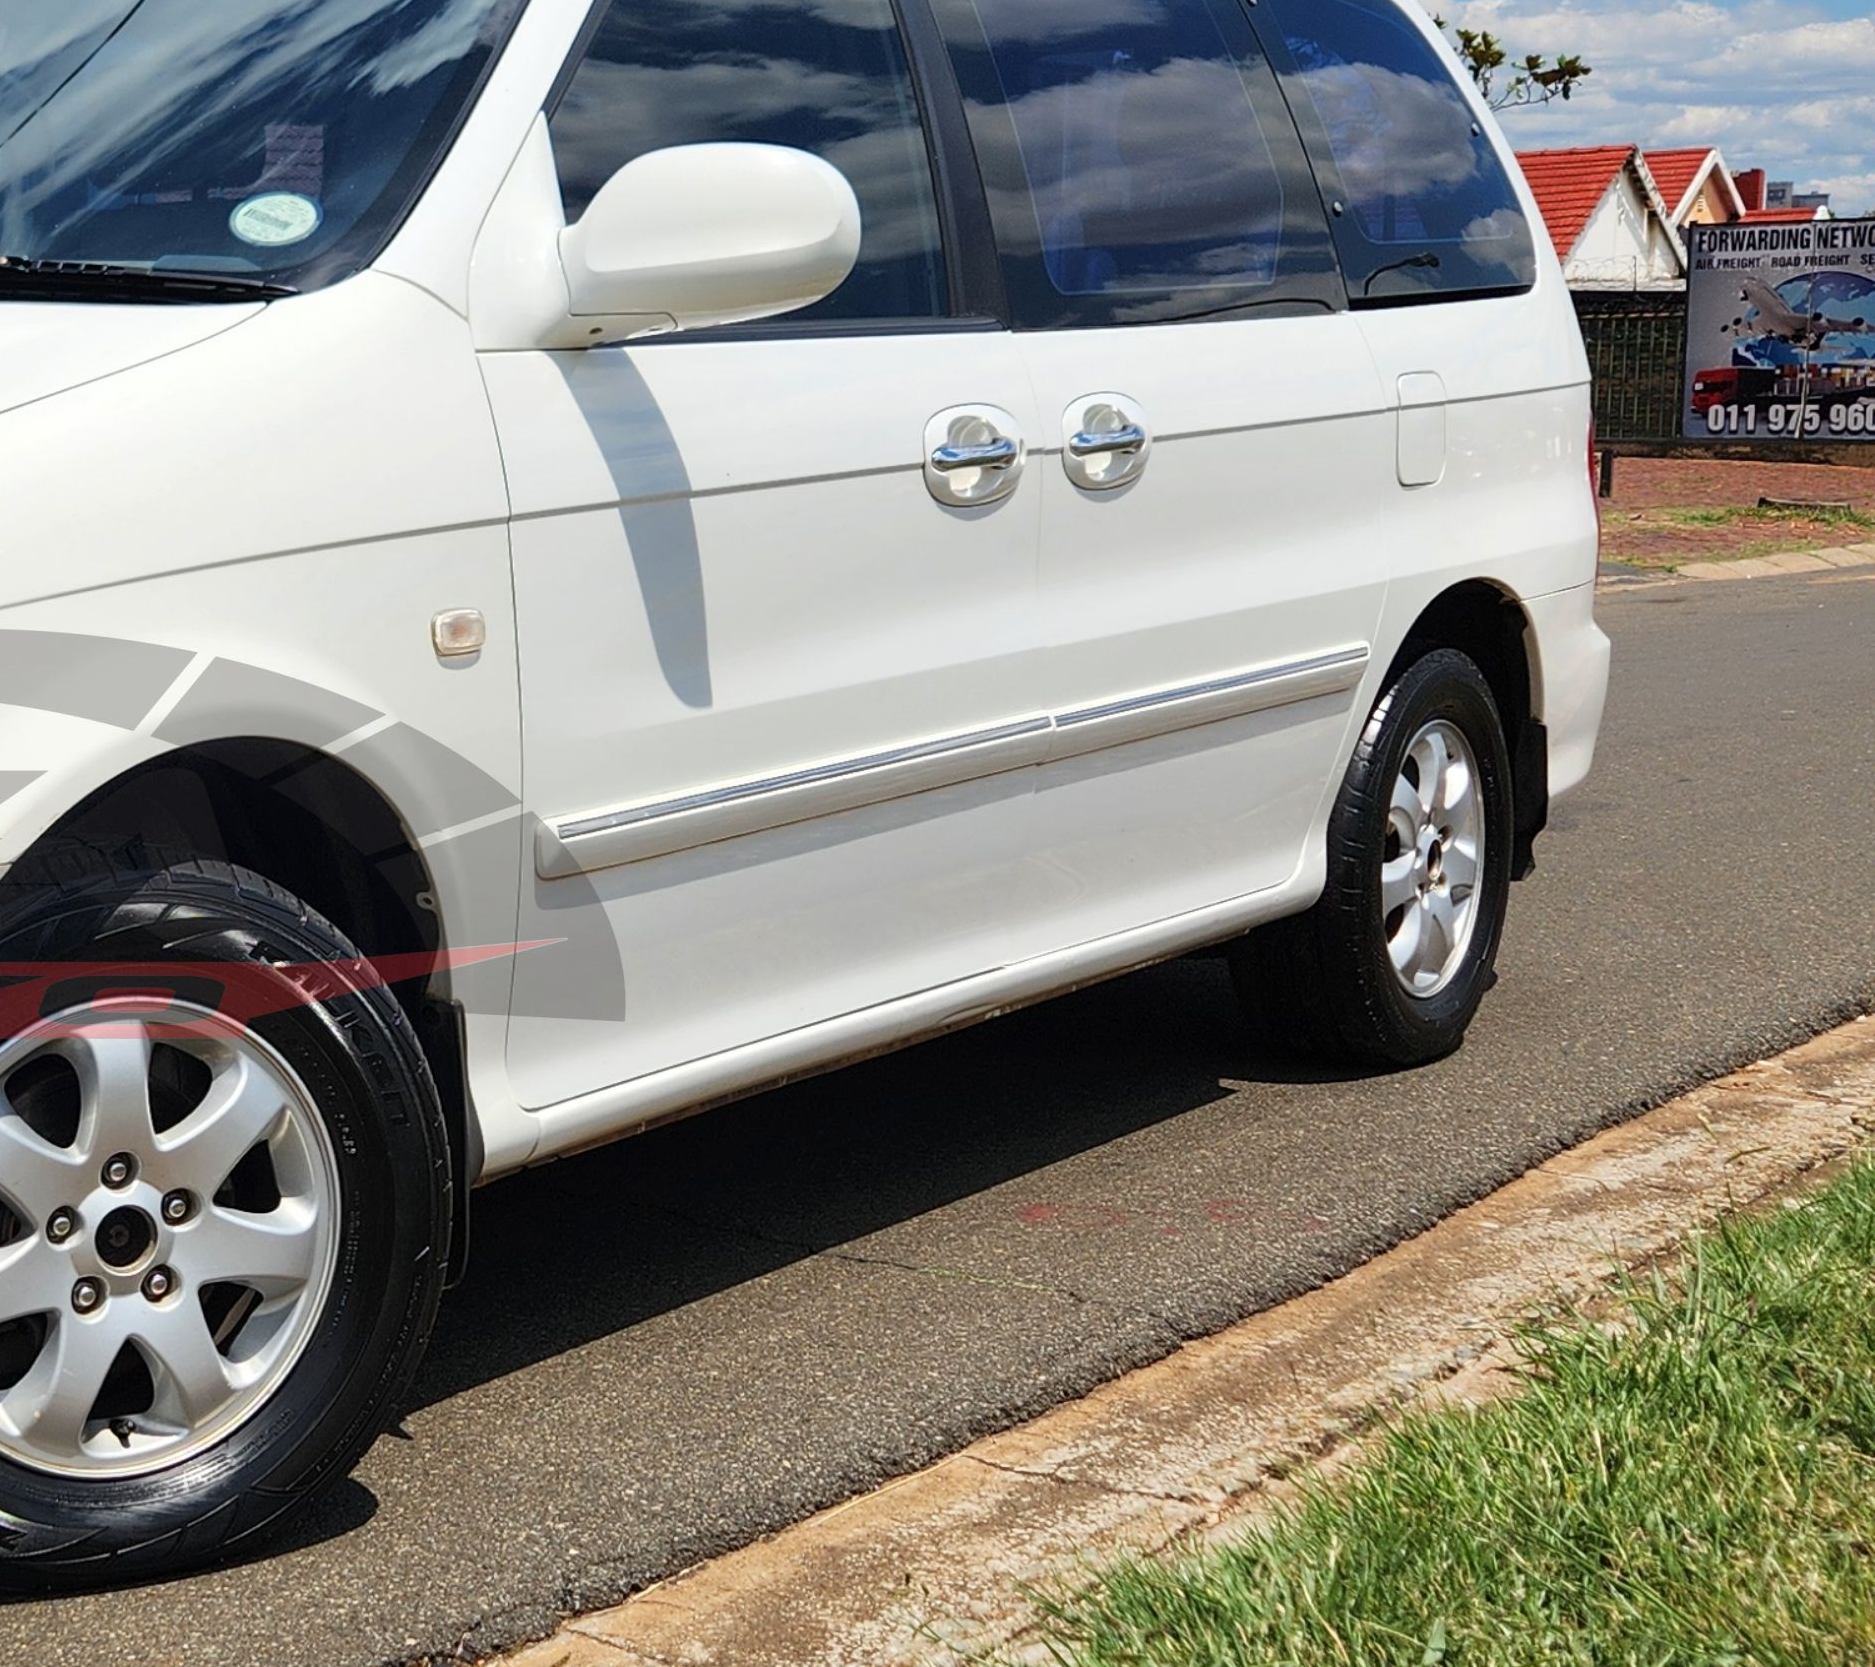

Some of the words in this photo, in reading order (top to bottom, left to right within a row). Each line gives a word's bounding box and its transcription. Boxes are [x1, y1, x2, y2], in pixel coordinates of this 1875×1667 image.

[1698, 227, 1810, 252] FORWARDING
[1695, 258, 1714, 270] AIR
[1717, 257, 1760, 269] FREIGHT
[1771, 255, 1801, 268] ROAD
[1805, 254, 1851, 267] FREIGHT
[1708, 403, 1756, 431] 011
[1769, 403, 1820, 431] 975
